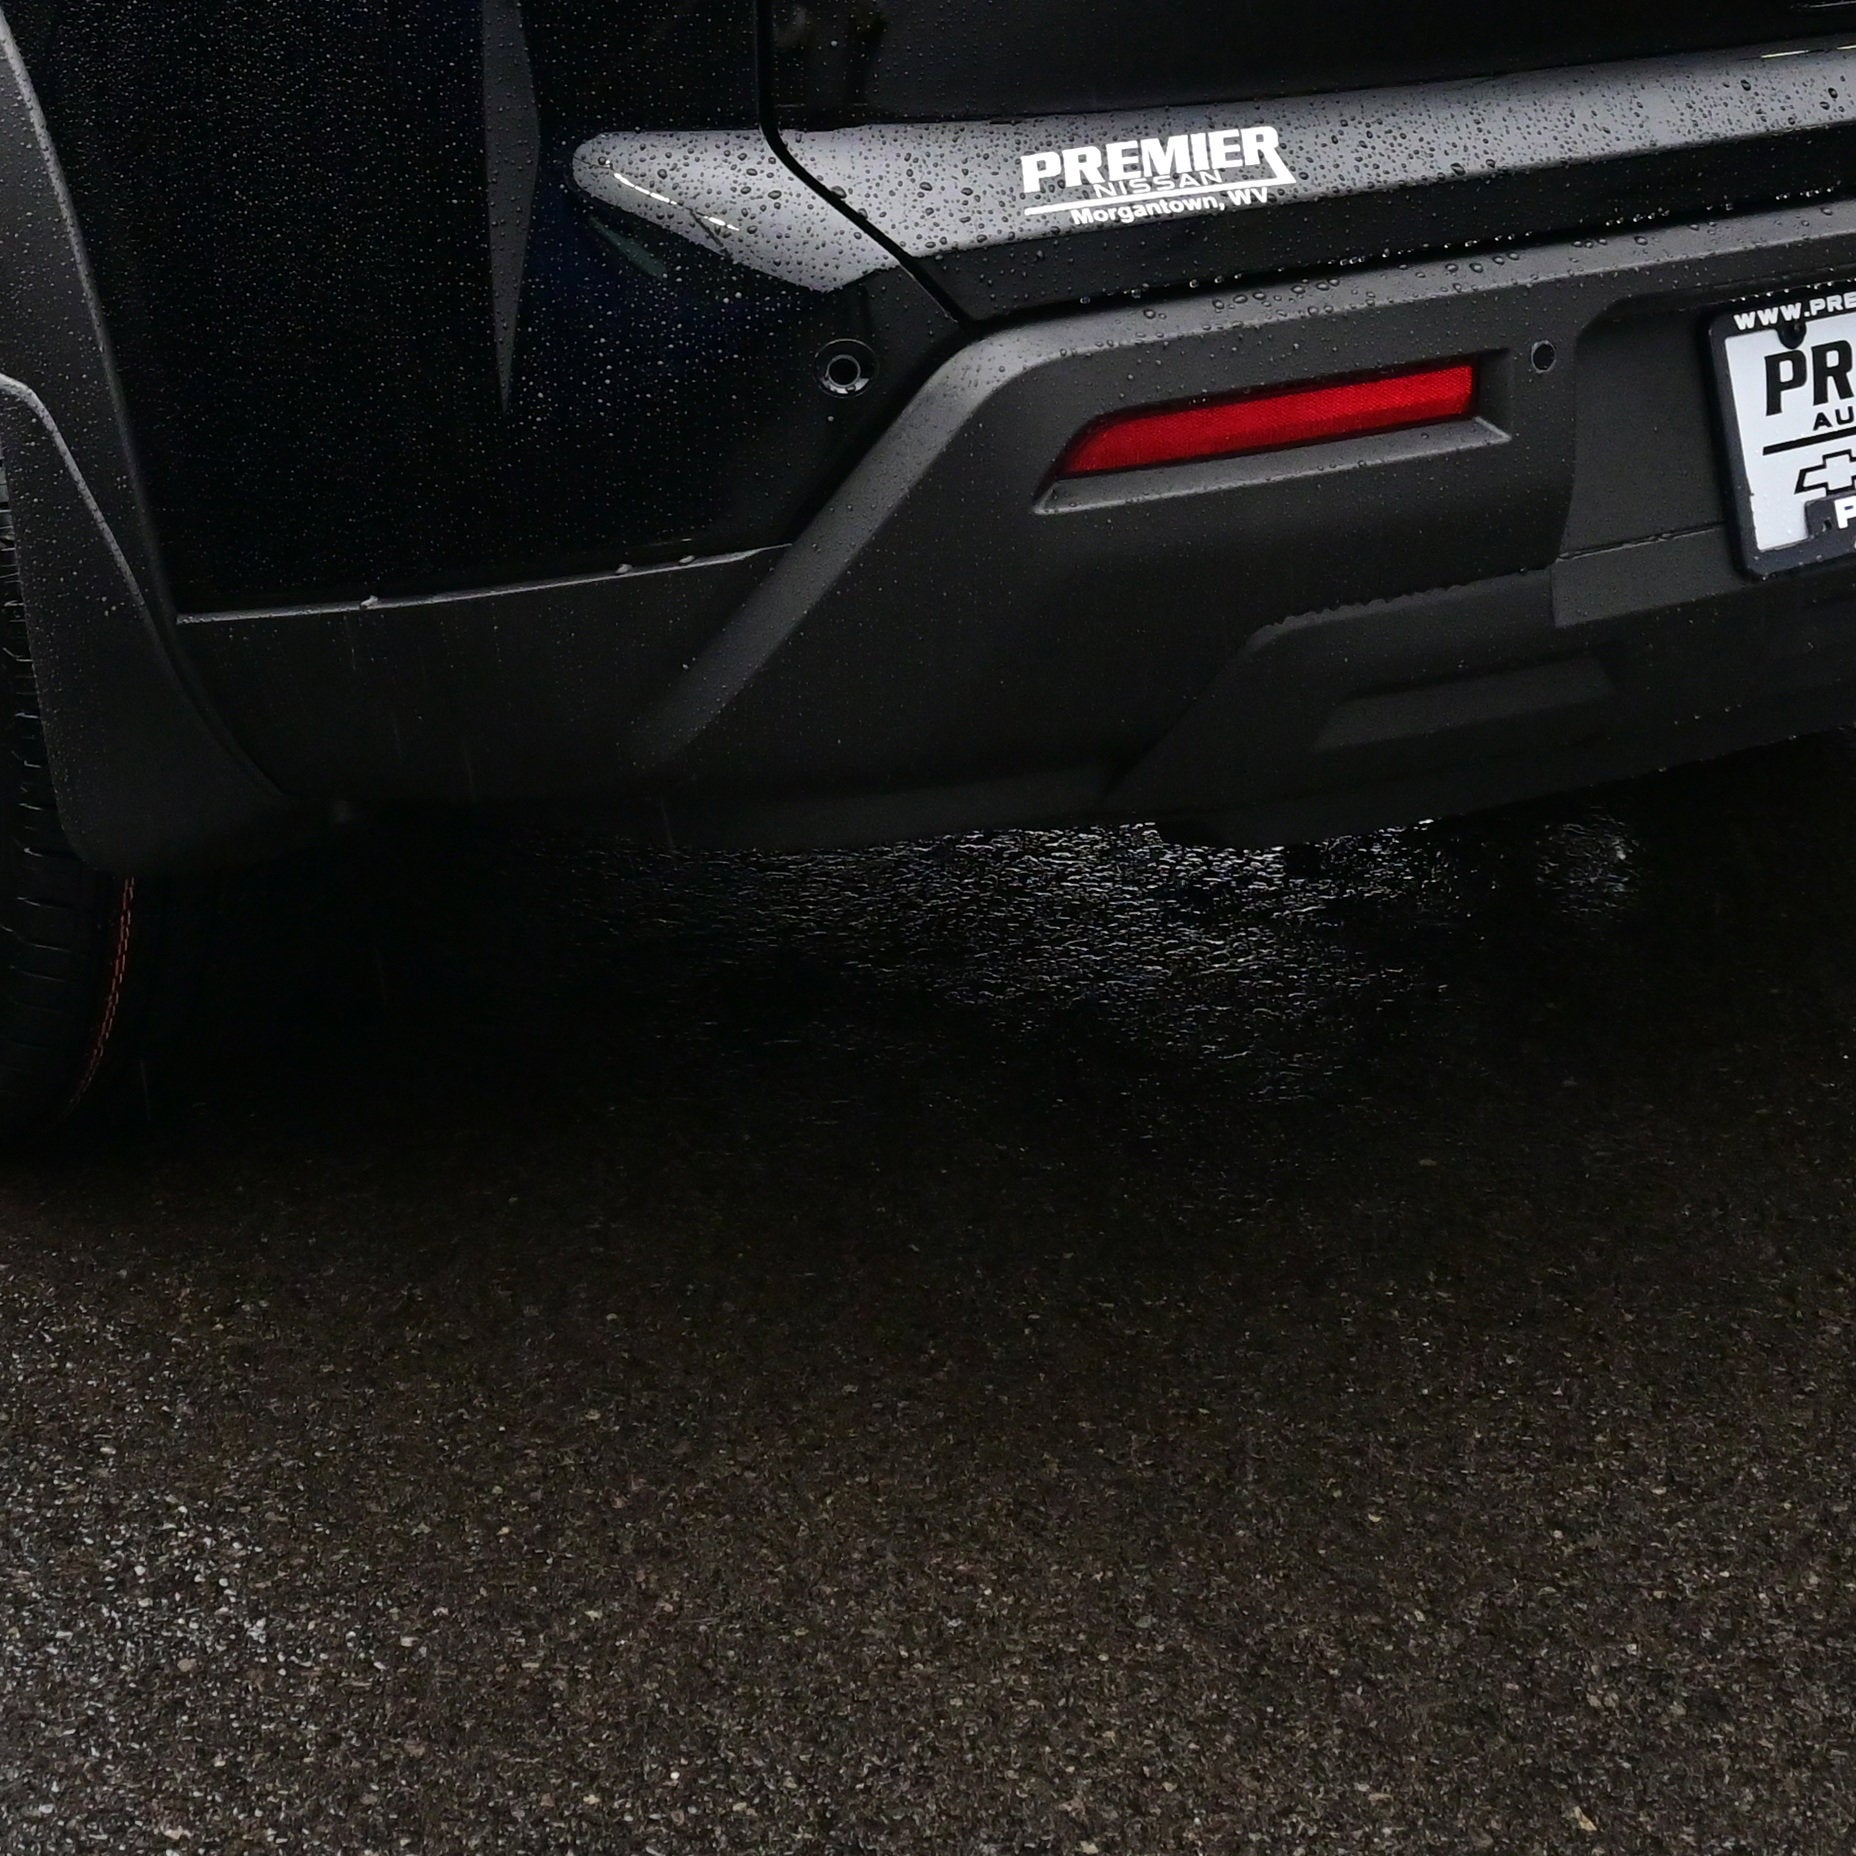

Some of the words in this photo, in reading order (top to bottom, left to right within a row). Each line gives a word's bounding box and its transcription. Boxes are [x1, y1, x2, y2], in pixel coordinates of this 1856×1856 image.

[1020, 125, 1296, 194] PREMIER
[1093, 170, 1223, 199] NISSAN
[1070, 191, 1226, 225] Morgantown,
[1221, 187, 1269, 207] WV
